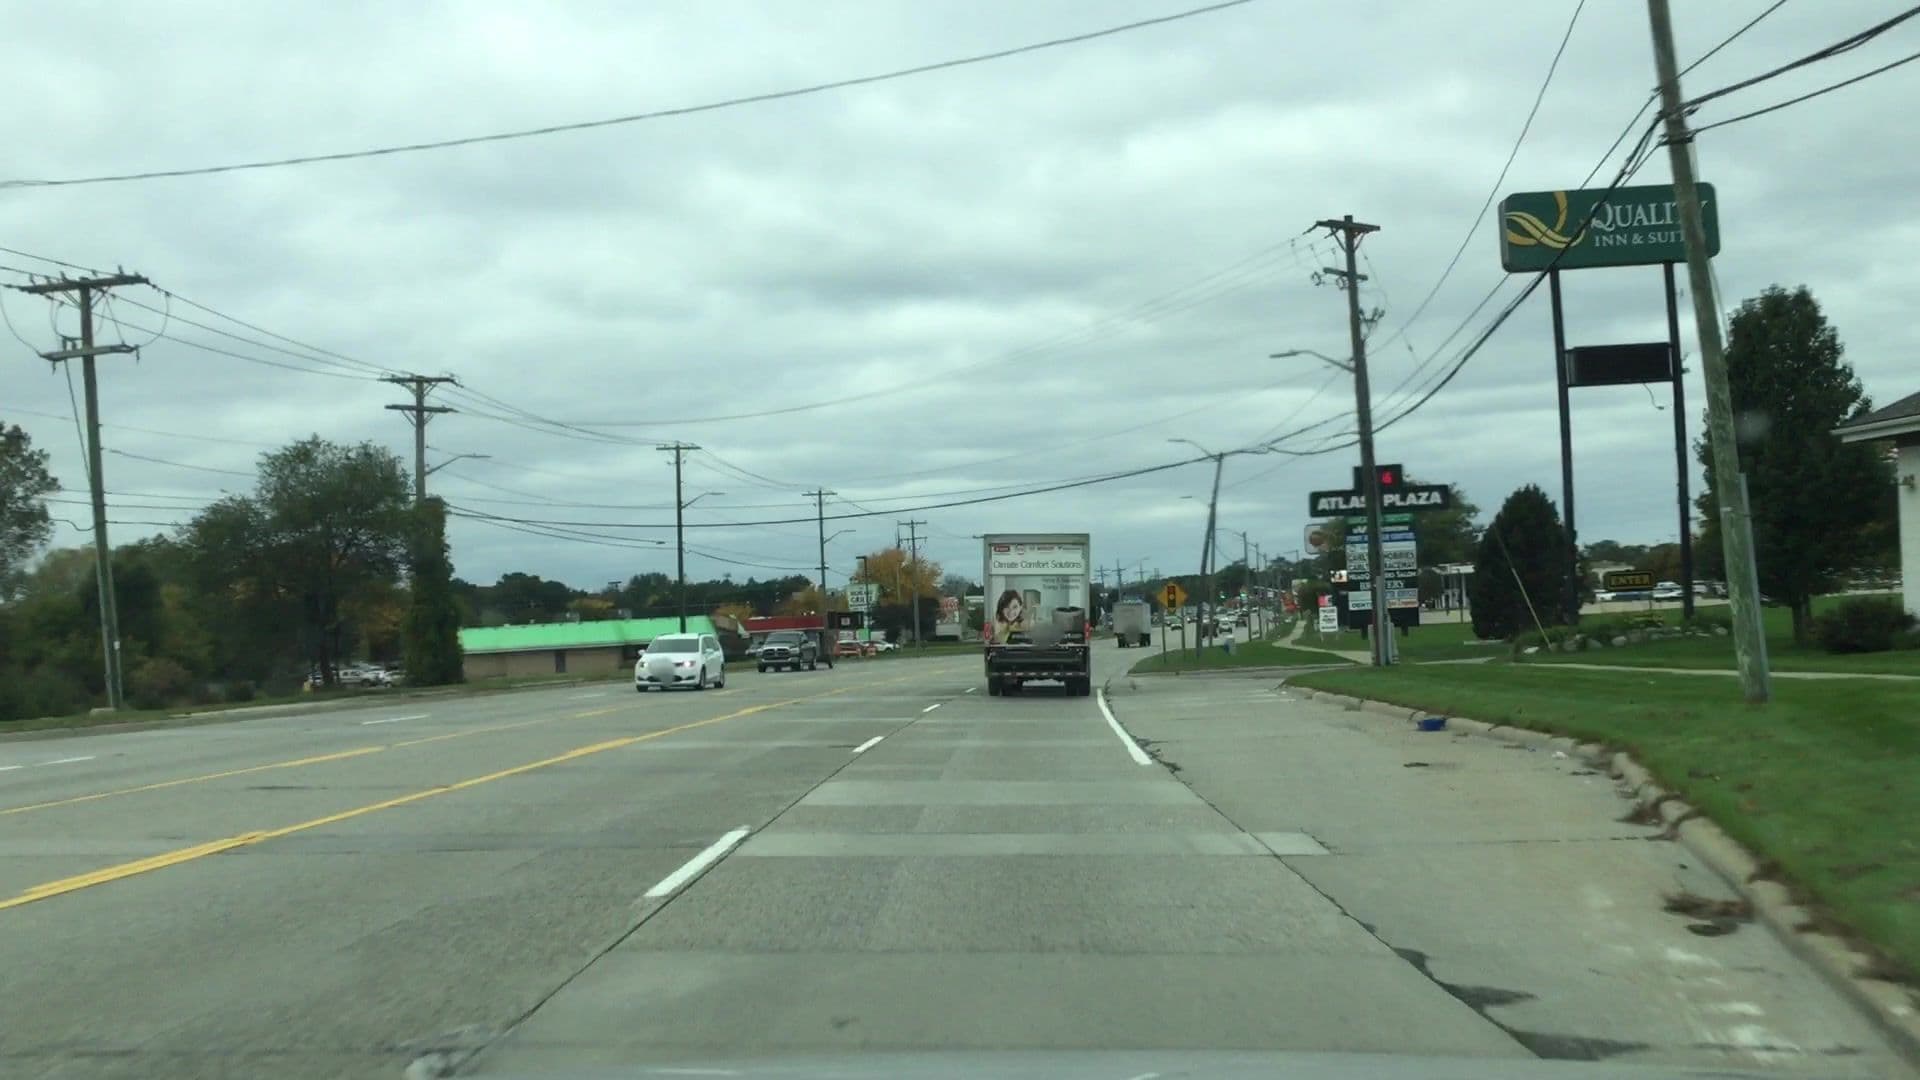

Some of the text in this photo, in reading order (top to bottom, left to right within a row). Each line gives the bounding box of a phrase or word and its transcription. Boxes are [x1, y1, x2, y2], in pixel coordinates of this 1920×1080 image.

[1591, 200, 1708, 231] QUALI
[1595, 234, 1628, 247] INN
[1631, 232, 1643, 244] &
[1383, 491, 1441, 507] PLAZA
[1020, 559, 1049, 568] Comfort
[1051, 559, 1081, 568] Solutions
